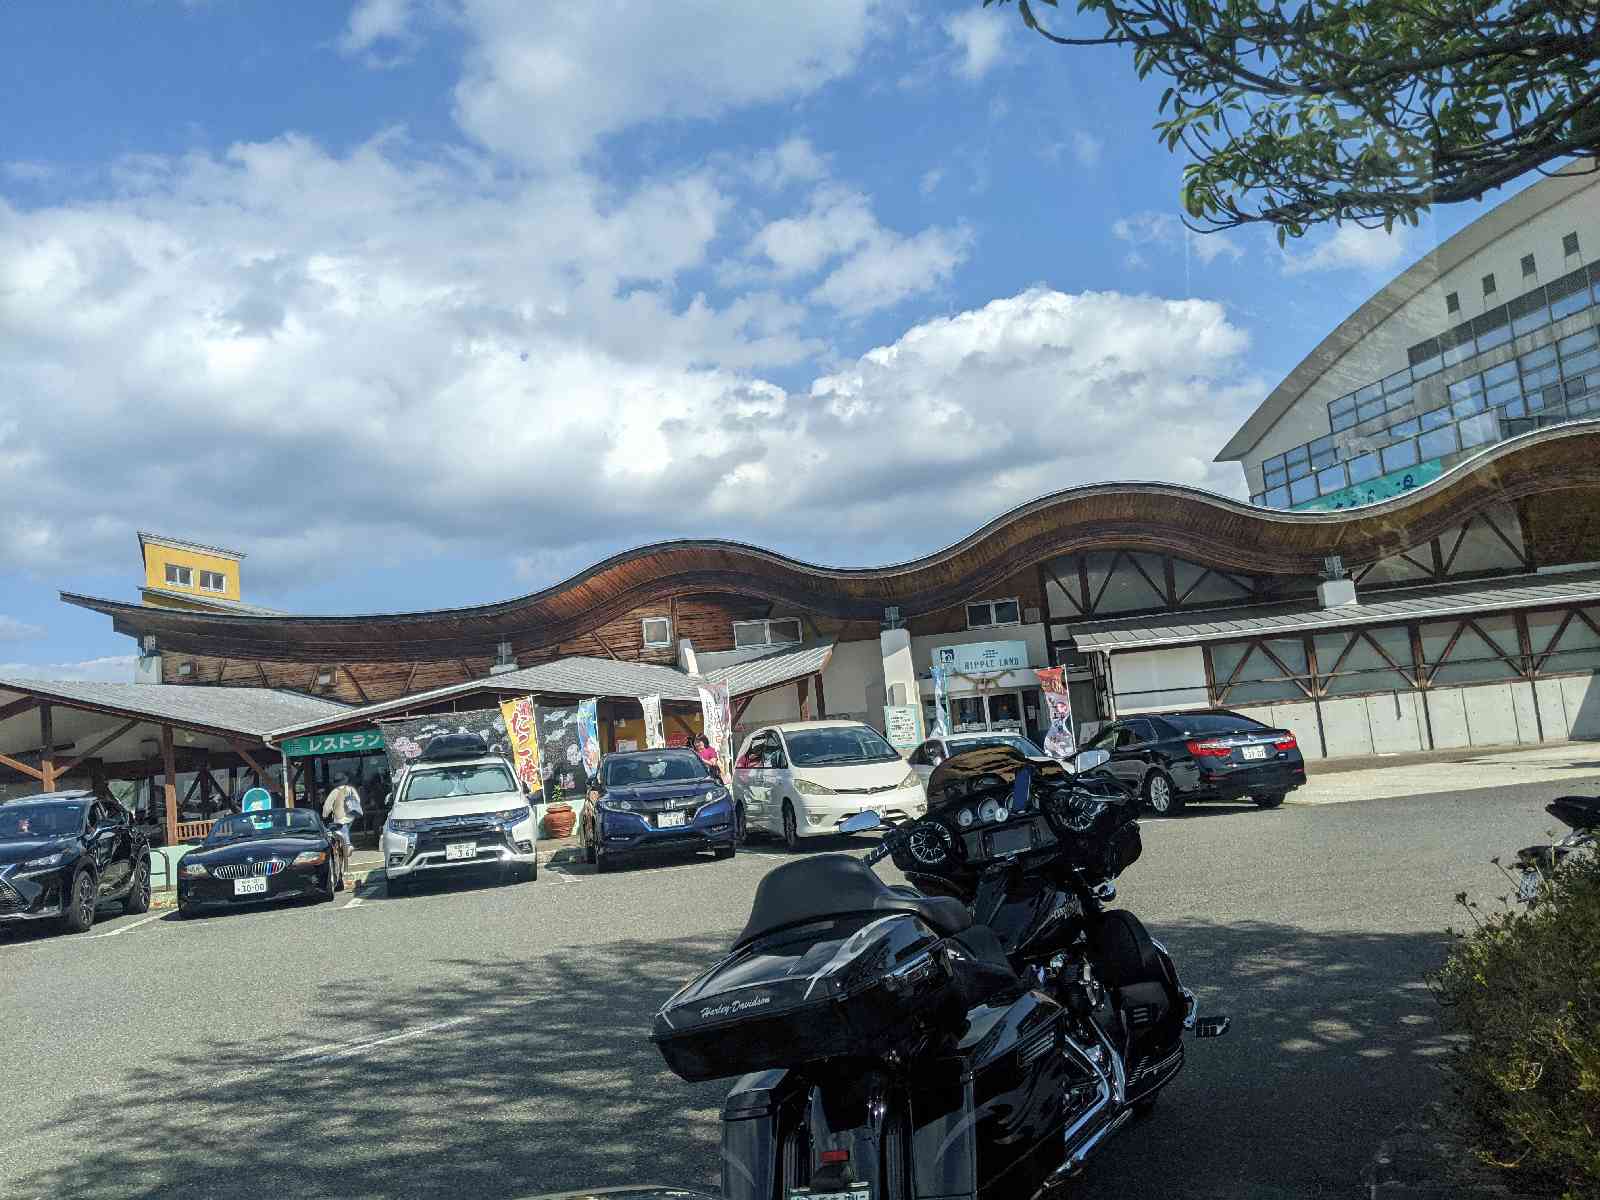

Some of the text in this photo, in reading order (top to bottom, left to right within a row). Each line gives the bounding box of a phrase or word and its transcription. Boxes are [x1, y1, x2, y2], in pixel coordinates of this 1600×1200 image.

[999, 656, 1020, 667] LAND
[309, 734, 380, 752] レストラン
[700, 995, 771, 1019] Harley-Davidson
